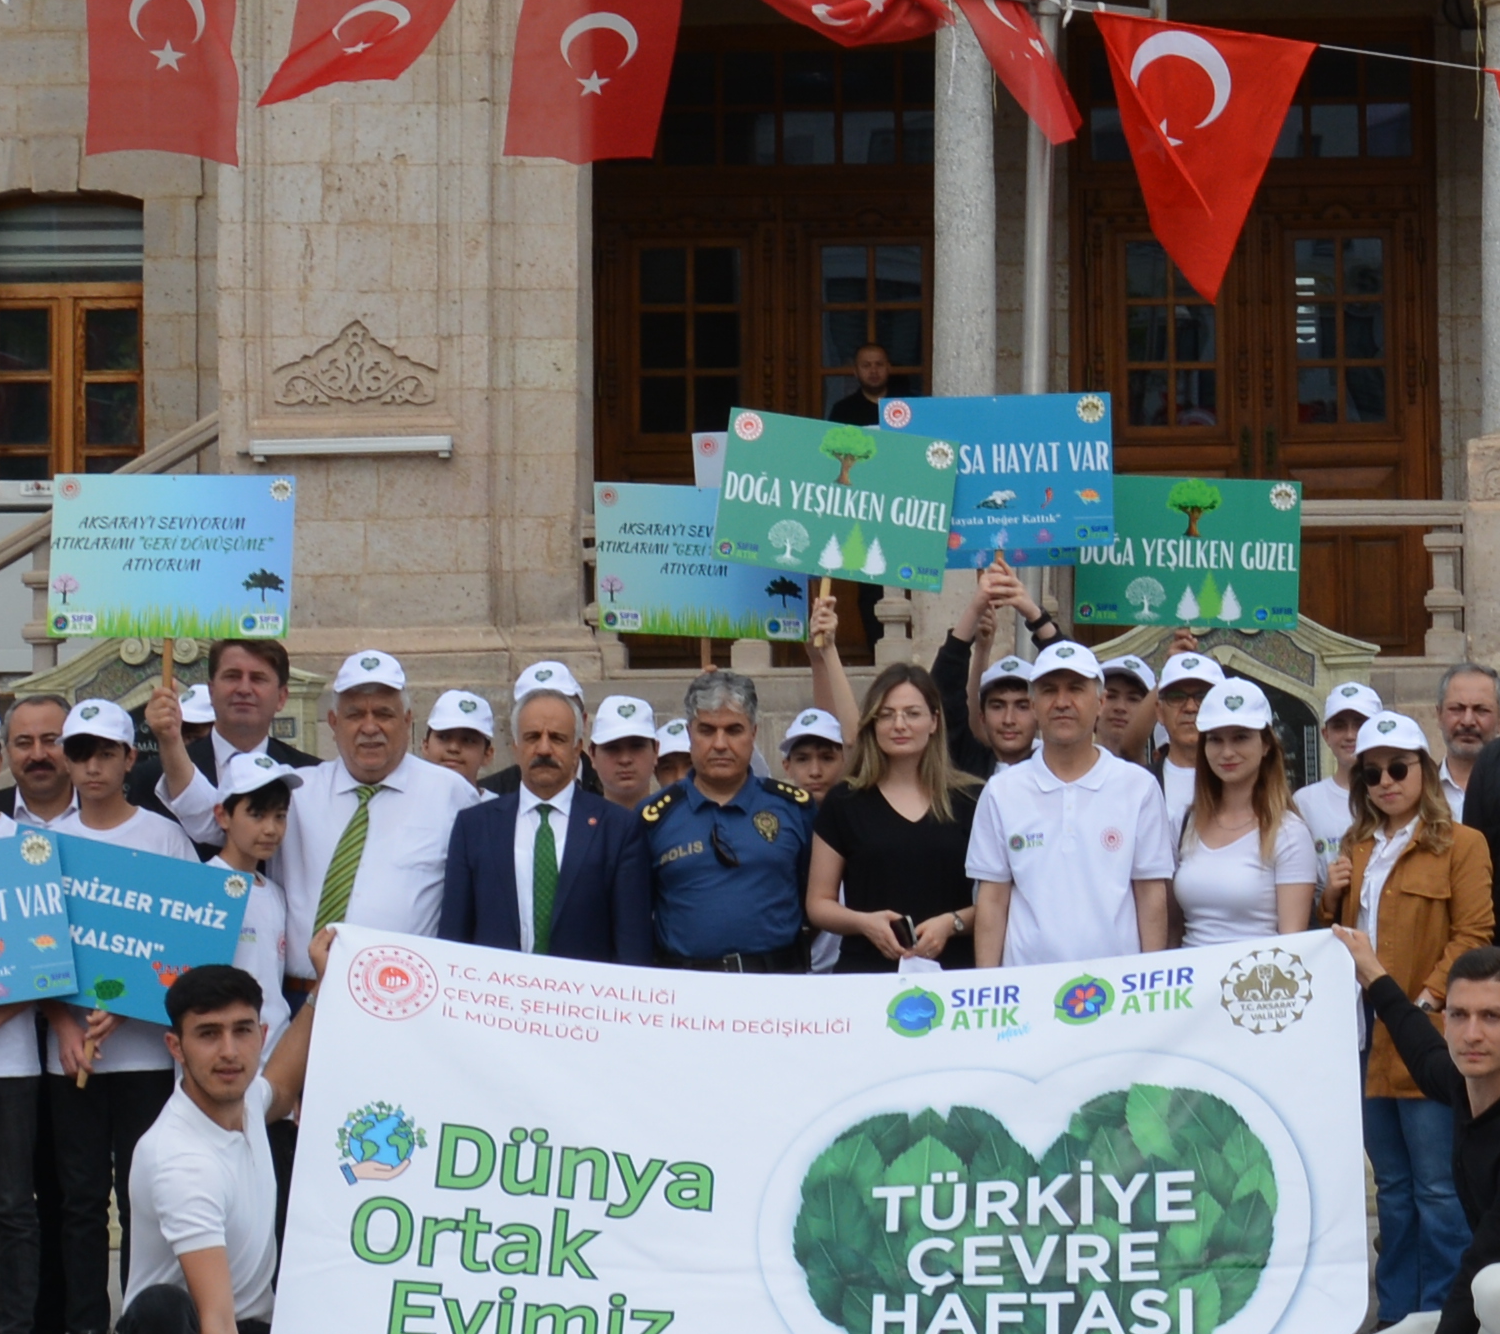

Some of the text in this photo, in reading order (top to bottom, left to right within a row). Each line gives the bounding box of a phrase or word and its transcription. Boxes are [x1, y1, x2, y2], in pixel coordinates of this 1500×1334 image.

[992, 441, 1060, 474] HAYAT
[1067, 440, 1110, 472] VAR
[724, 470, 948, 533] DOĞA YEŞİLKEN GÜZEL
[158, 514, 246, 530] SEVİYORUM
[51, 536, 135, 551] ATIKLARIMI
[596, 541, 668, 555] ATIKLARIMI
[1141, 536, 1234, 572] YEŞİLKEN
[1240, 538, 1297, 572] GÜZEL
[122, 557, 201, 571] ATIYORUM
[660, 562, 728, 577] ATIYORUM
[15, 882, 64, 919] VAR
[159, 897, 228, 931] TEMİZ
[446, 964, 676, 1006] T.C. AKSARAY VALİLİĞİ
[950, 985, 1020, 1008] SIFIR
[1120, 967, 1195, 994] SIFIR
[443, 987, 852, 1038] ÇEVRE, ŞEHİRCİLİK VE İKLİM DEĞİŞİKLİĞİ
[950, 1006, 1020, 1031] ATIK
[1120, 987, 1194, 1016] ATIK
[1255, 1001, 1297, 1011] AKSARAY
[441, 1004, 600, 1043] İL MÜDÜRLÜĞÜ
[435, 1122, 715, 1217] Dünya
[871, 1160, 1198, 1233] TÜRKİYE
[349, 1196, 603, 1280] Ortak
[906, 1232, 1161, 1296] ÇEVRE
